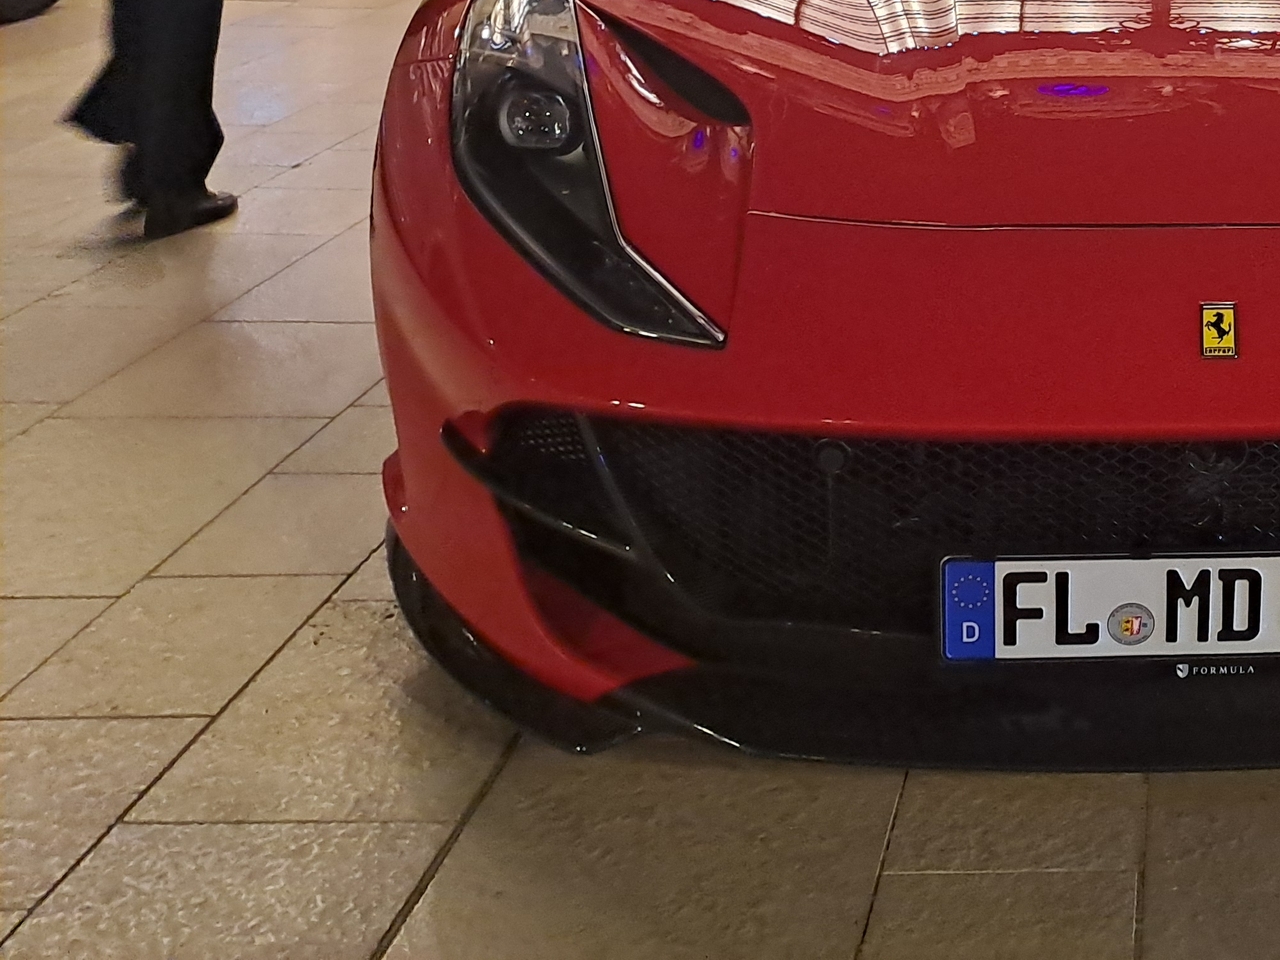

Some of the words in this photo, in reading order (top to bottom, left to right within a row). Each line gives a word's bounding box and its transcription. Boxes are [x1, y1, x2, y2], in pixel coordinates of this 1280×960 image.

[1002, 571, 1100, 646] FL
[1165, 568, 1262, 643] MD
[962, 621, 980, 642] D
[1192, 665, 1255, 676] FORMULA
